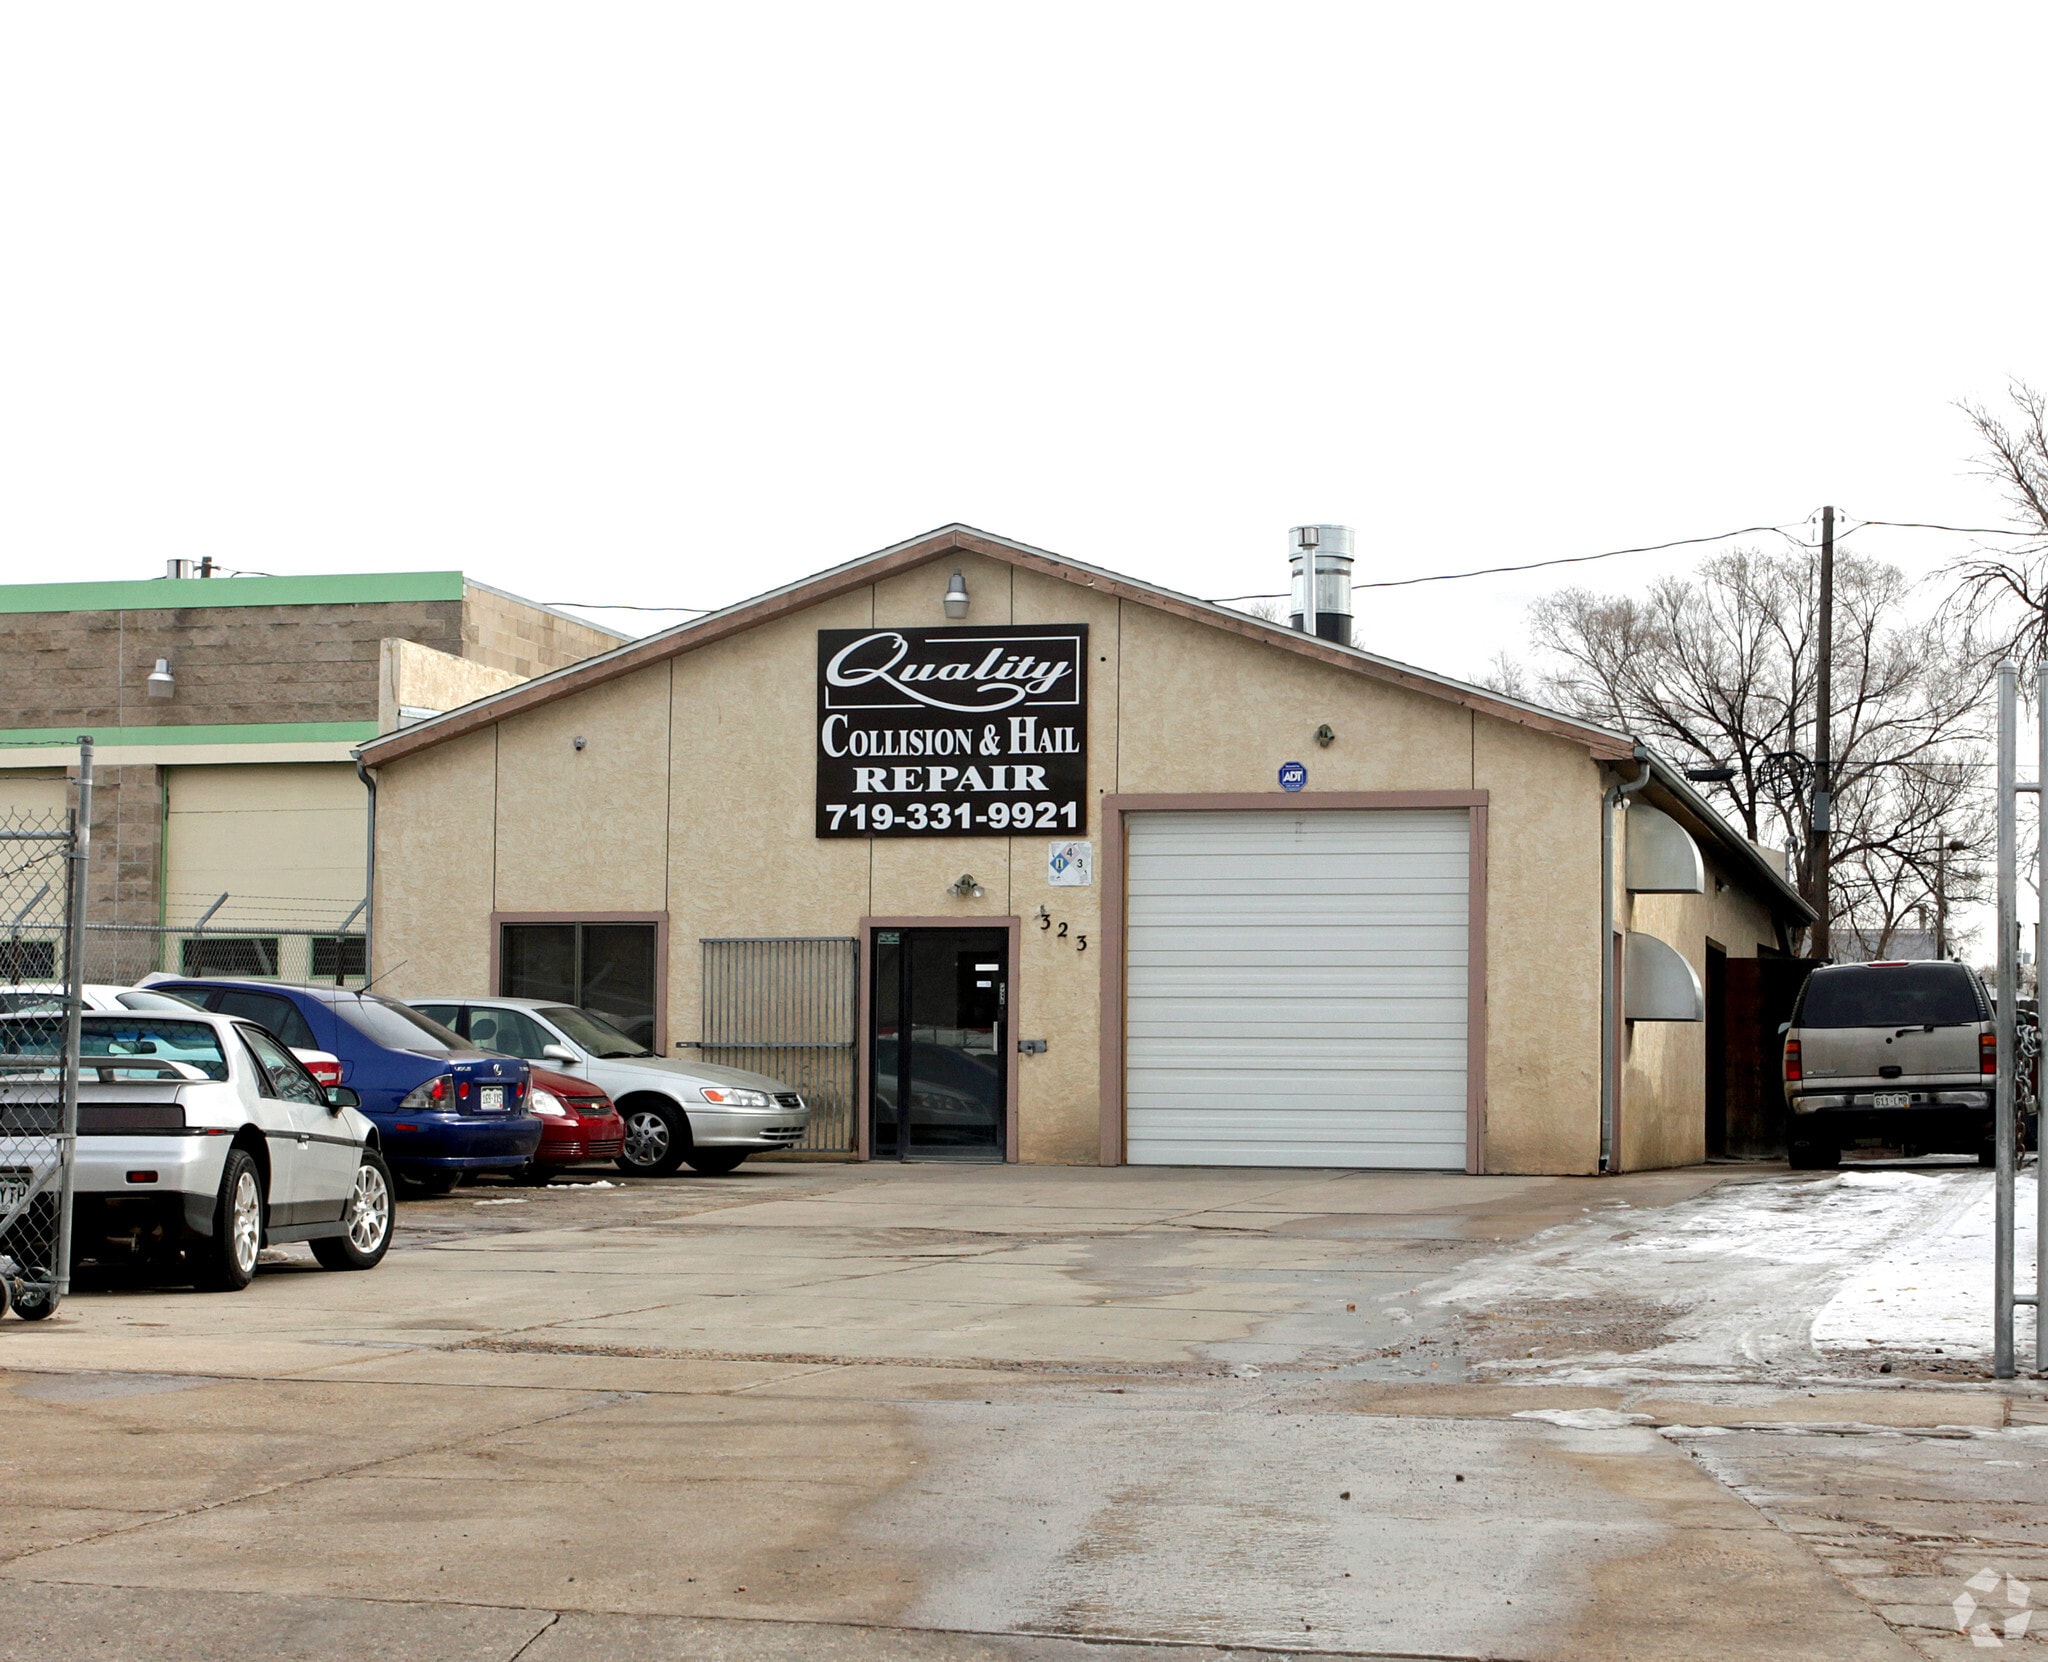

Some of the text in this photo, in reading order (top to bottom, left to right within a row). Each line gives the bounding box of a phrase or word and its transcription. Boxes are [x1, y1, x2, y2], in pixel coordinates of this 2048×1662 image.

[826, 632, 1072, 712] Quality
[821, 714, 1080, 758] COLLISION & HAIL
[852, 764, 1049, 793] REPAIR
[1283, 771, 1303, 782] ADT
[826, 801, 1077, 831] 719-331-9921
[1066, 848, 1073, 858] 4
[1077, 859, 1083, 869] 3
[1040, 914, 1087, 952] 323
